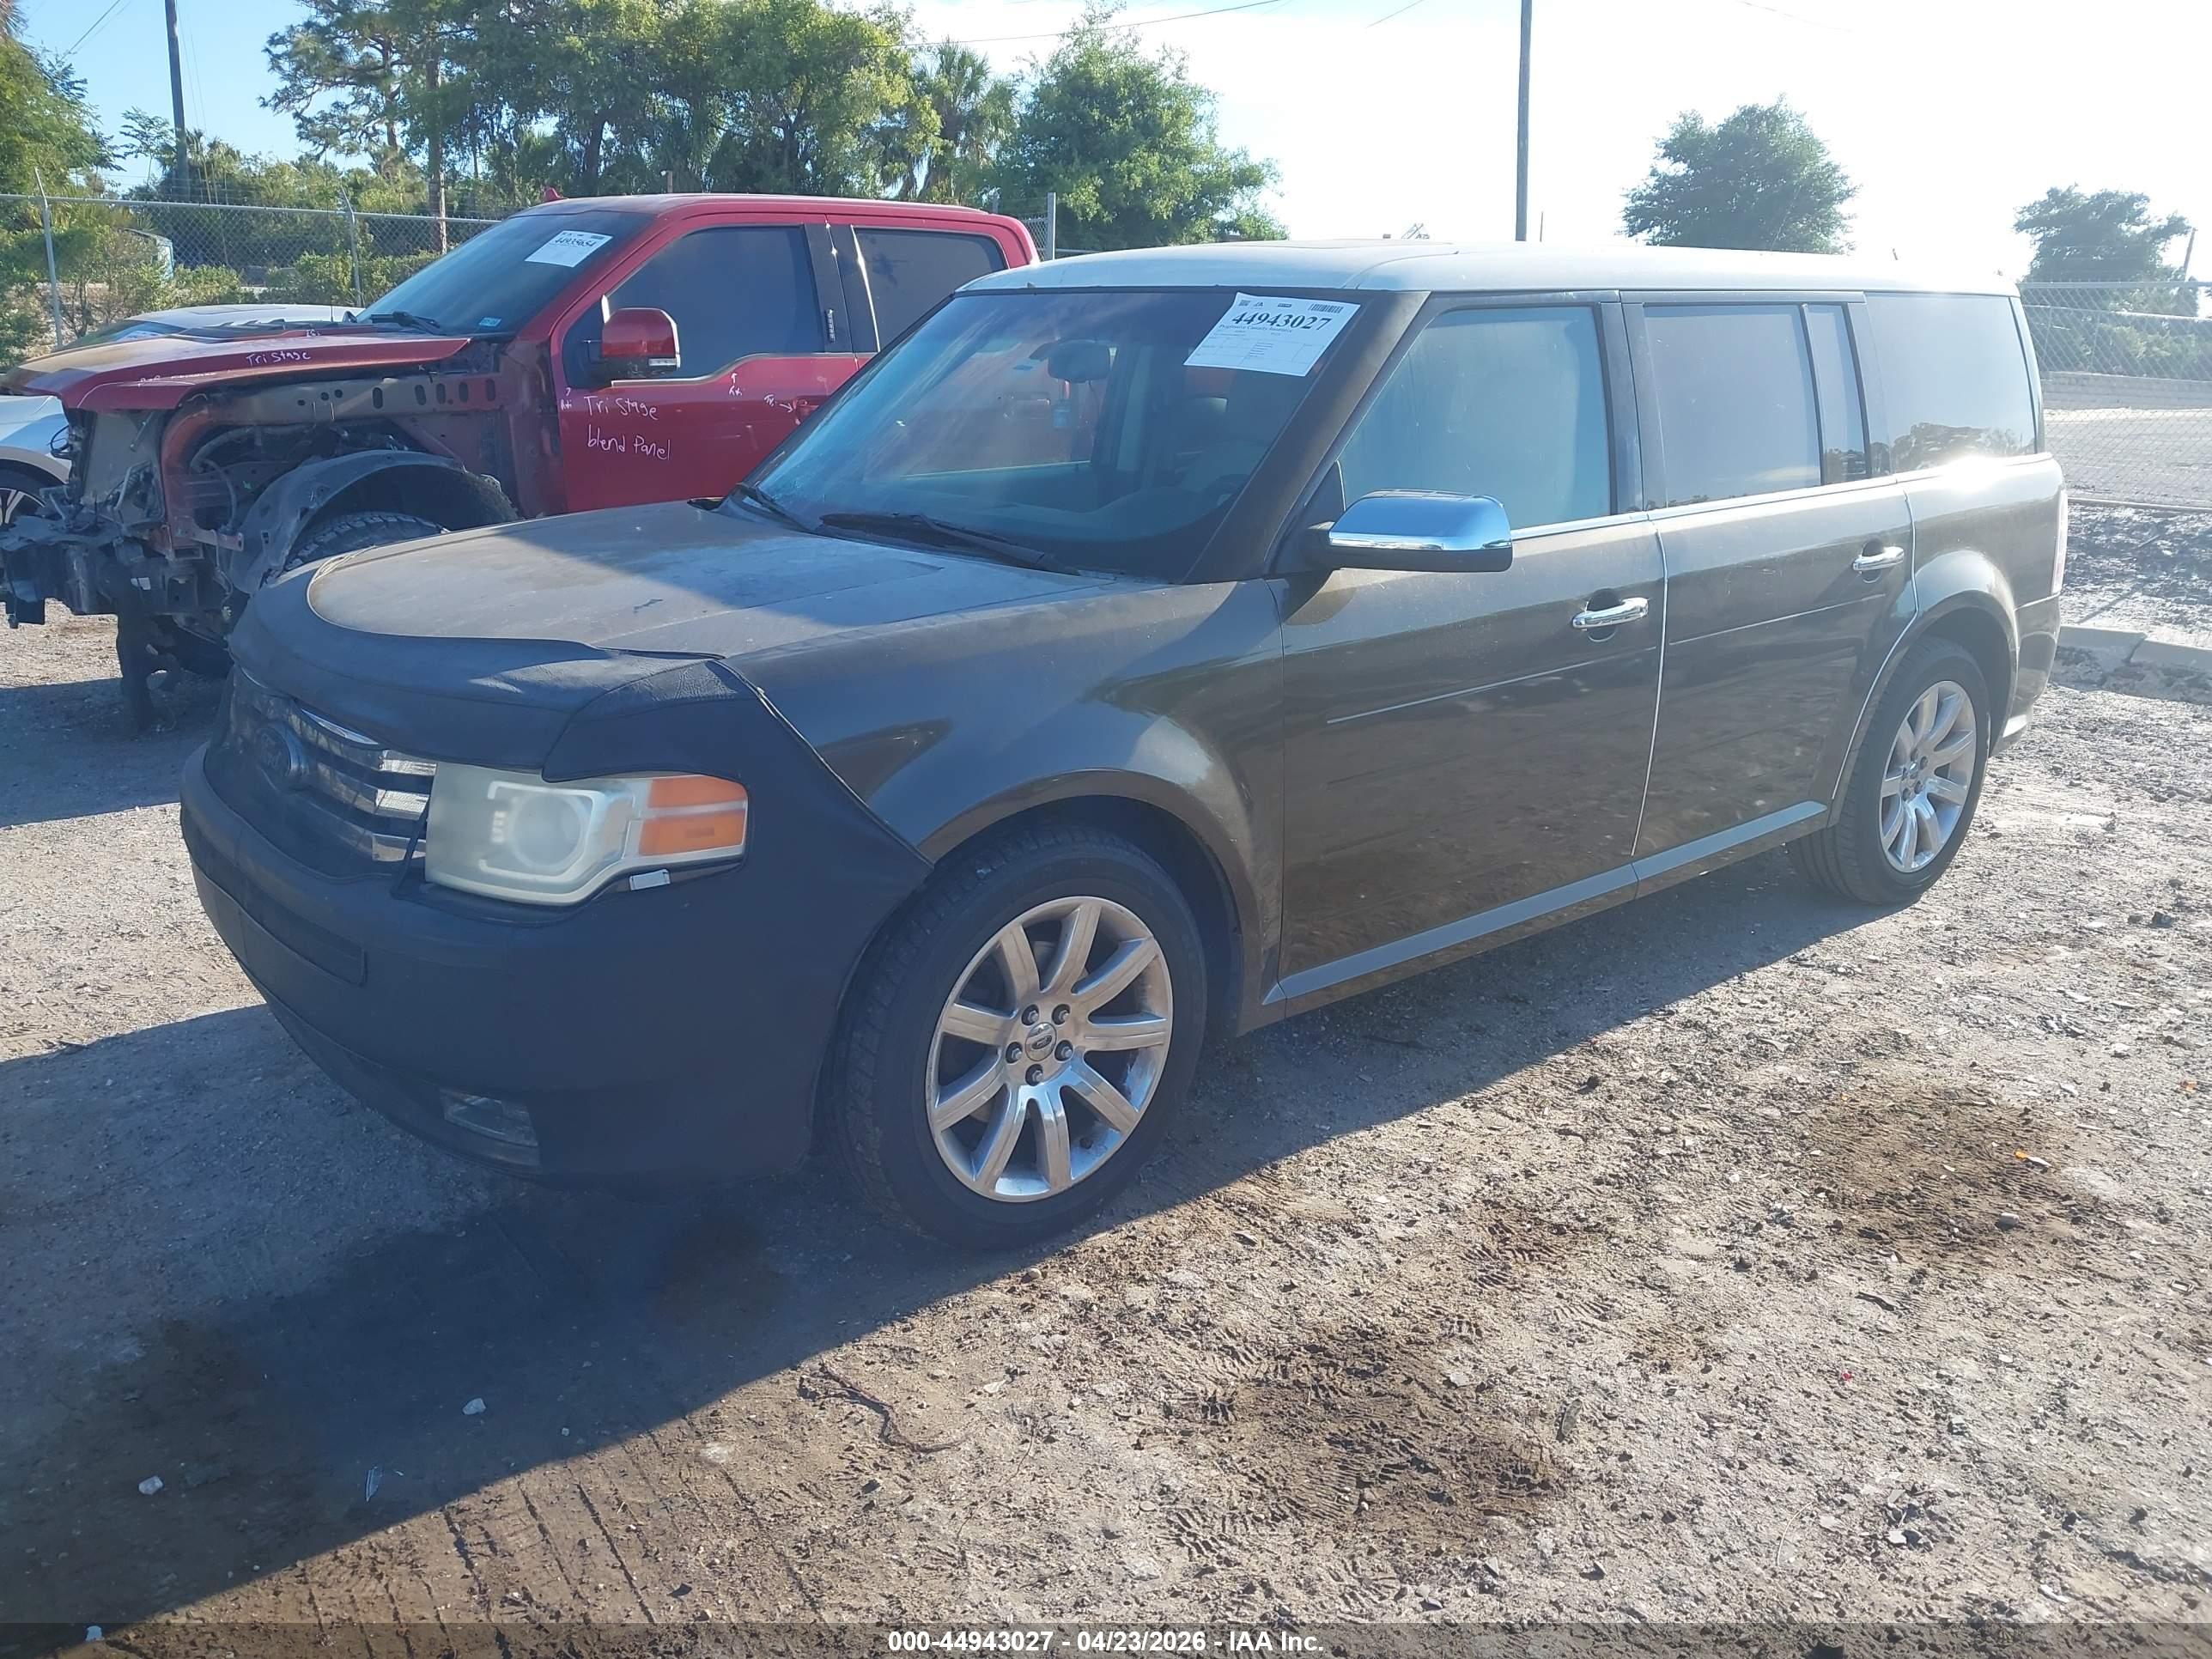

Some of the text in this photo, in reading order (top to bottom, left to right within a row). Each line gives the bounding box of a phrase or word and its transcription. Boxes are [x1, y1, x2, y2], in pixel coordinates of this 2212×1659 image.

[1231, 311, 1333, 331] 44943027
[246, 350, 311, 367] Tri Stage
[584, 395, 659, 421] Tri Stage
[588, 424, 671, 460] blend Panel
